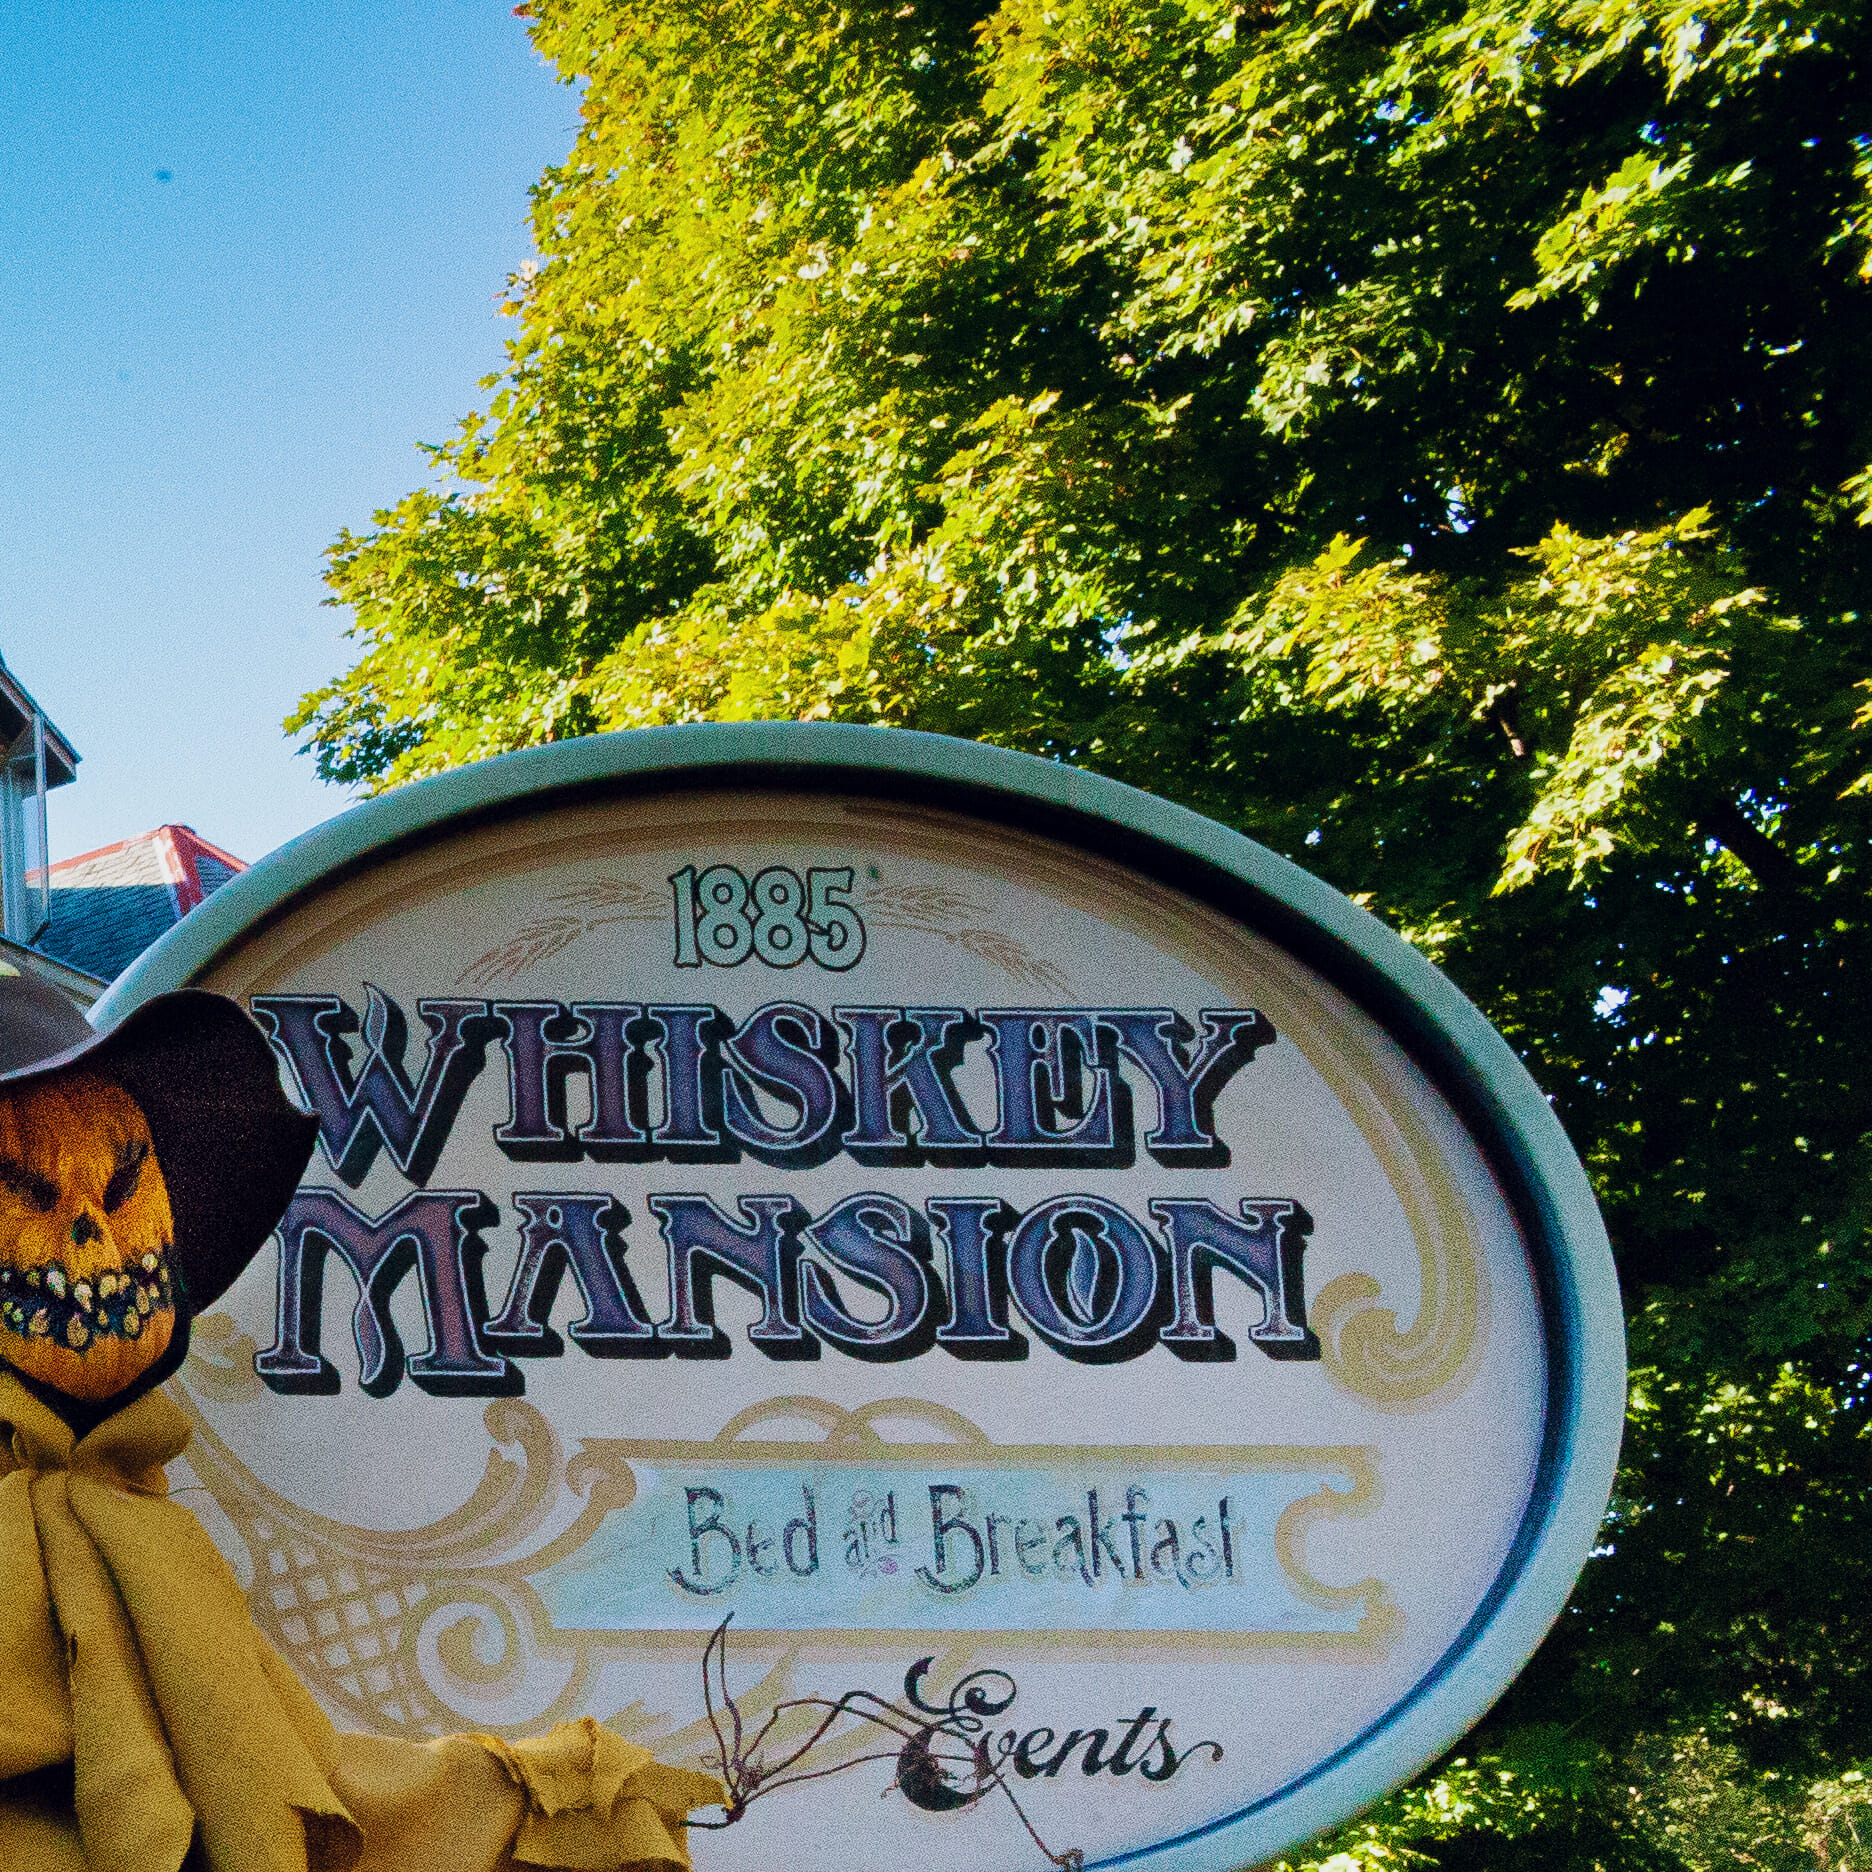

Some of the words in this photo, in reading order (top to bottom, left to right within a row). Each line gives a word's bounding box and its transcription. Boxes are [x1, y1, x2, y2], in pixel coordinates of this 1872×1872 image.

[667, 864, 867, 973] 1885
[251, 985, 1276, 1187] WHISKEY
[254, 1190, 1322, 1398] MANSION
[666, 1485, 819, 1595] Bed
[913, 1484, 1236, 1593] Breakfast
[896, 1655, 1224, 1812] Events
